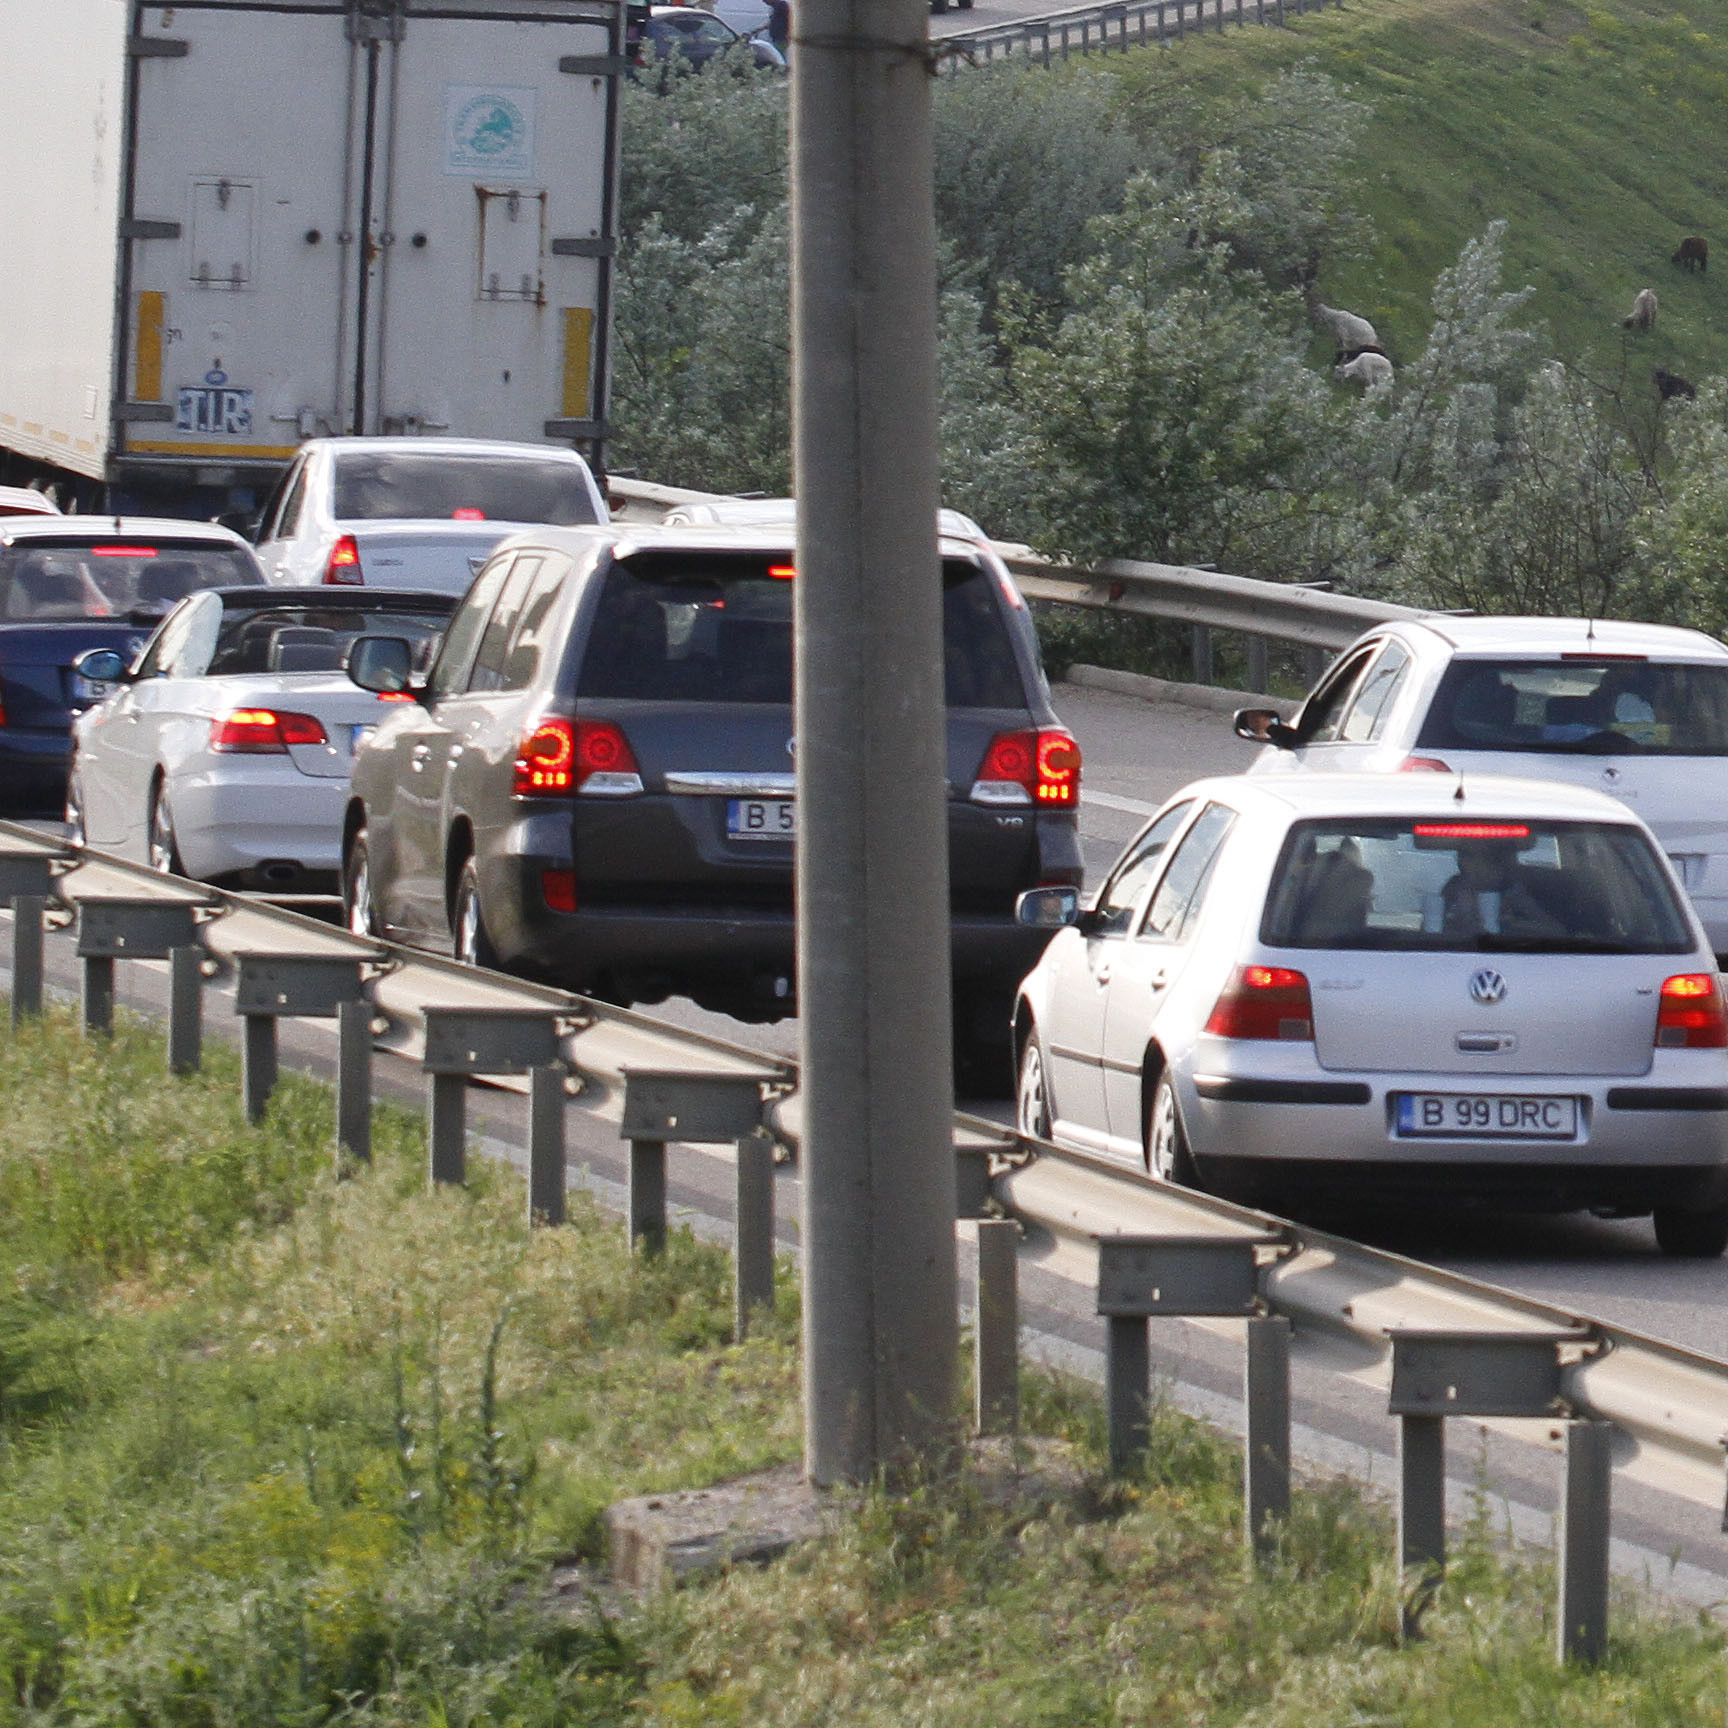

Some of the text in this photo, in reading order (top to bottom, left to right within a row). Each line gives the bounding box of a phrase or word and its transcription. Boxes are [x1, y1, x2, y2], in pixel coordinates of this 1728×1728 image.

[183, 389, 248, 433] TIR
[747, 803, 765, 829] B
[1423, 1099, 1561, 1129] B 99 DRC
